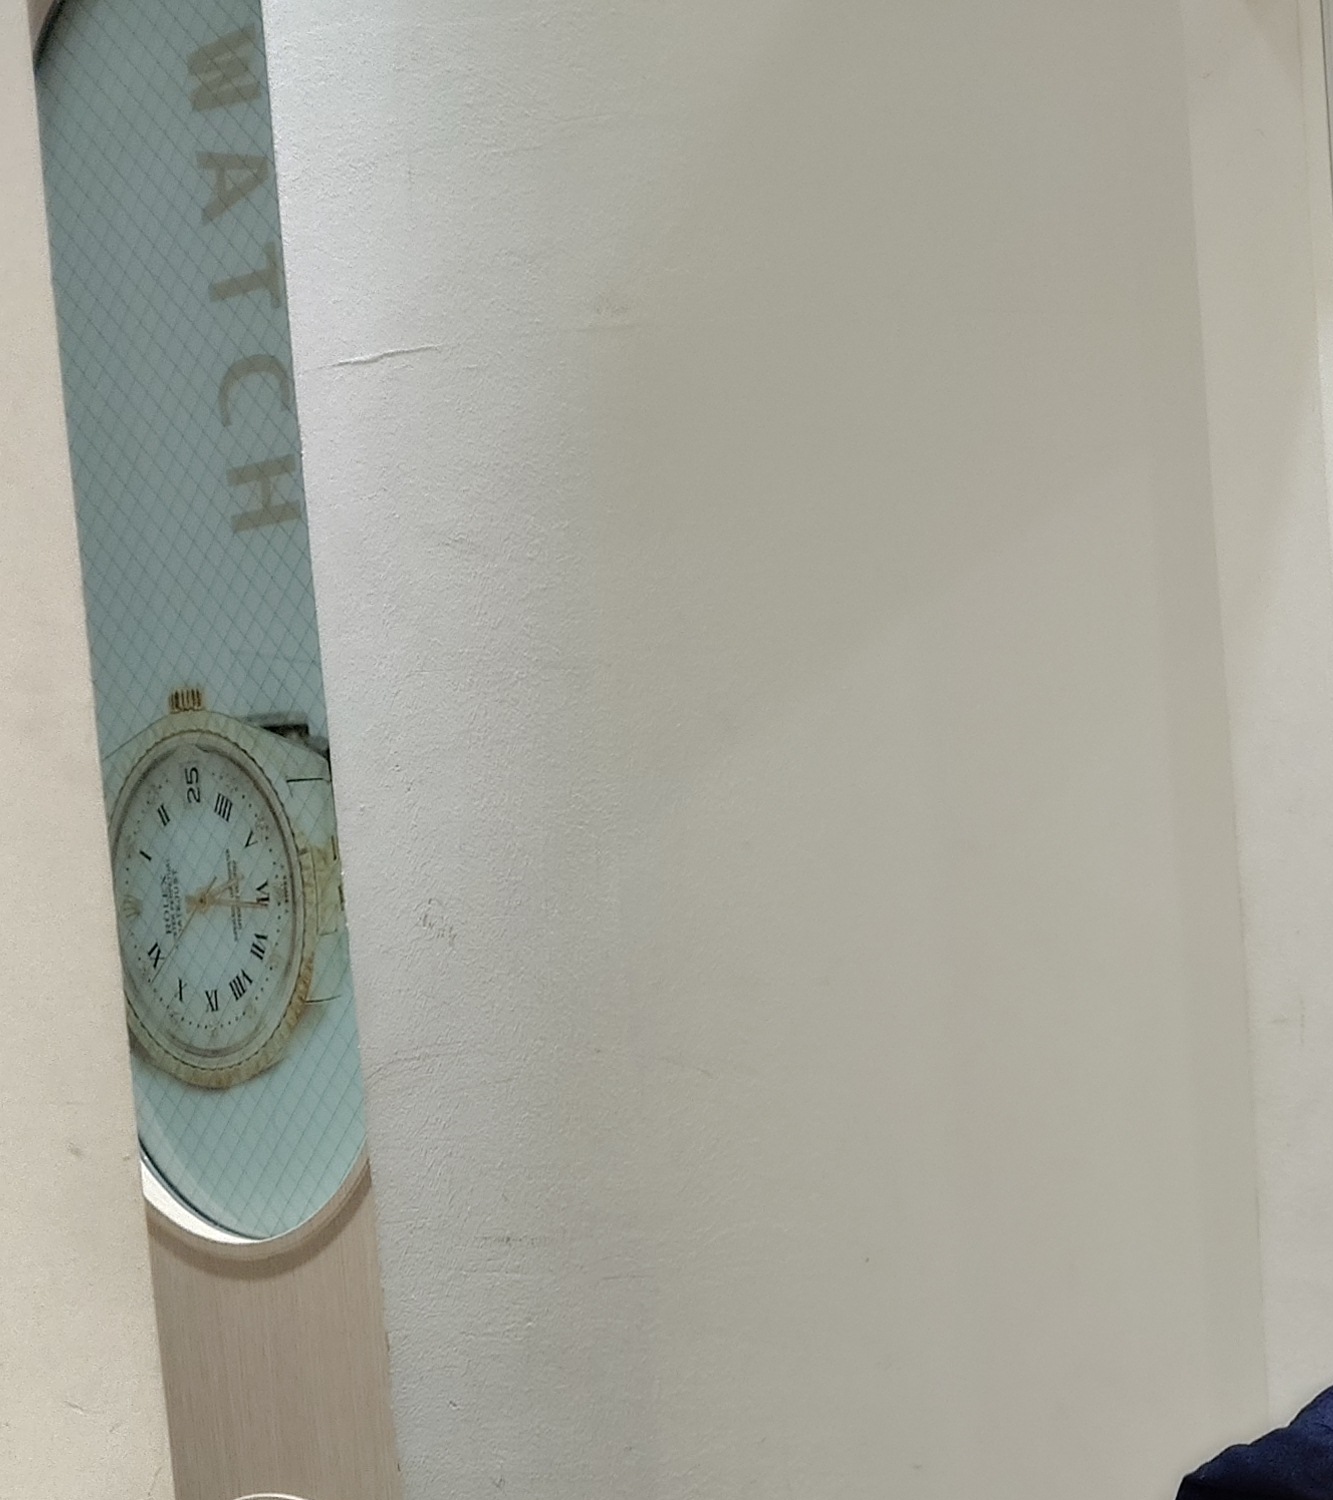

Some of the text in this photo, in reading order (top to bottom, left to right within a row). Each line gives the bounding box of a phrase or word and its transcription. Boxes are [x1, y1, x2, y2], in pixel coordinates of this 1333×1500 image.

[187, 23, 301, 533] WATCH
[184, 767, 201, 803] 25
[160, 875, 172, 935] ROLEX
